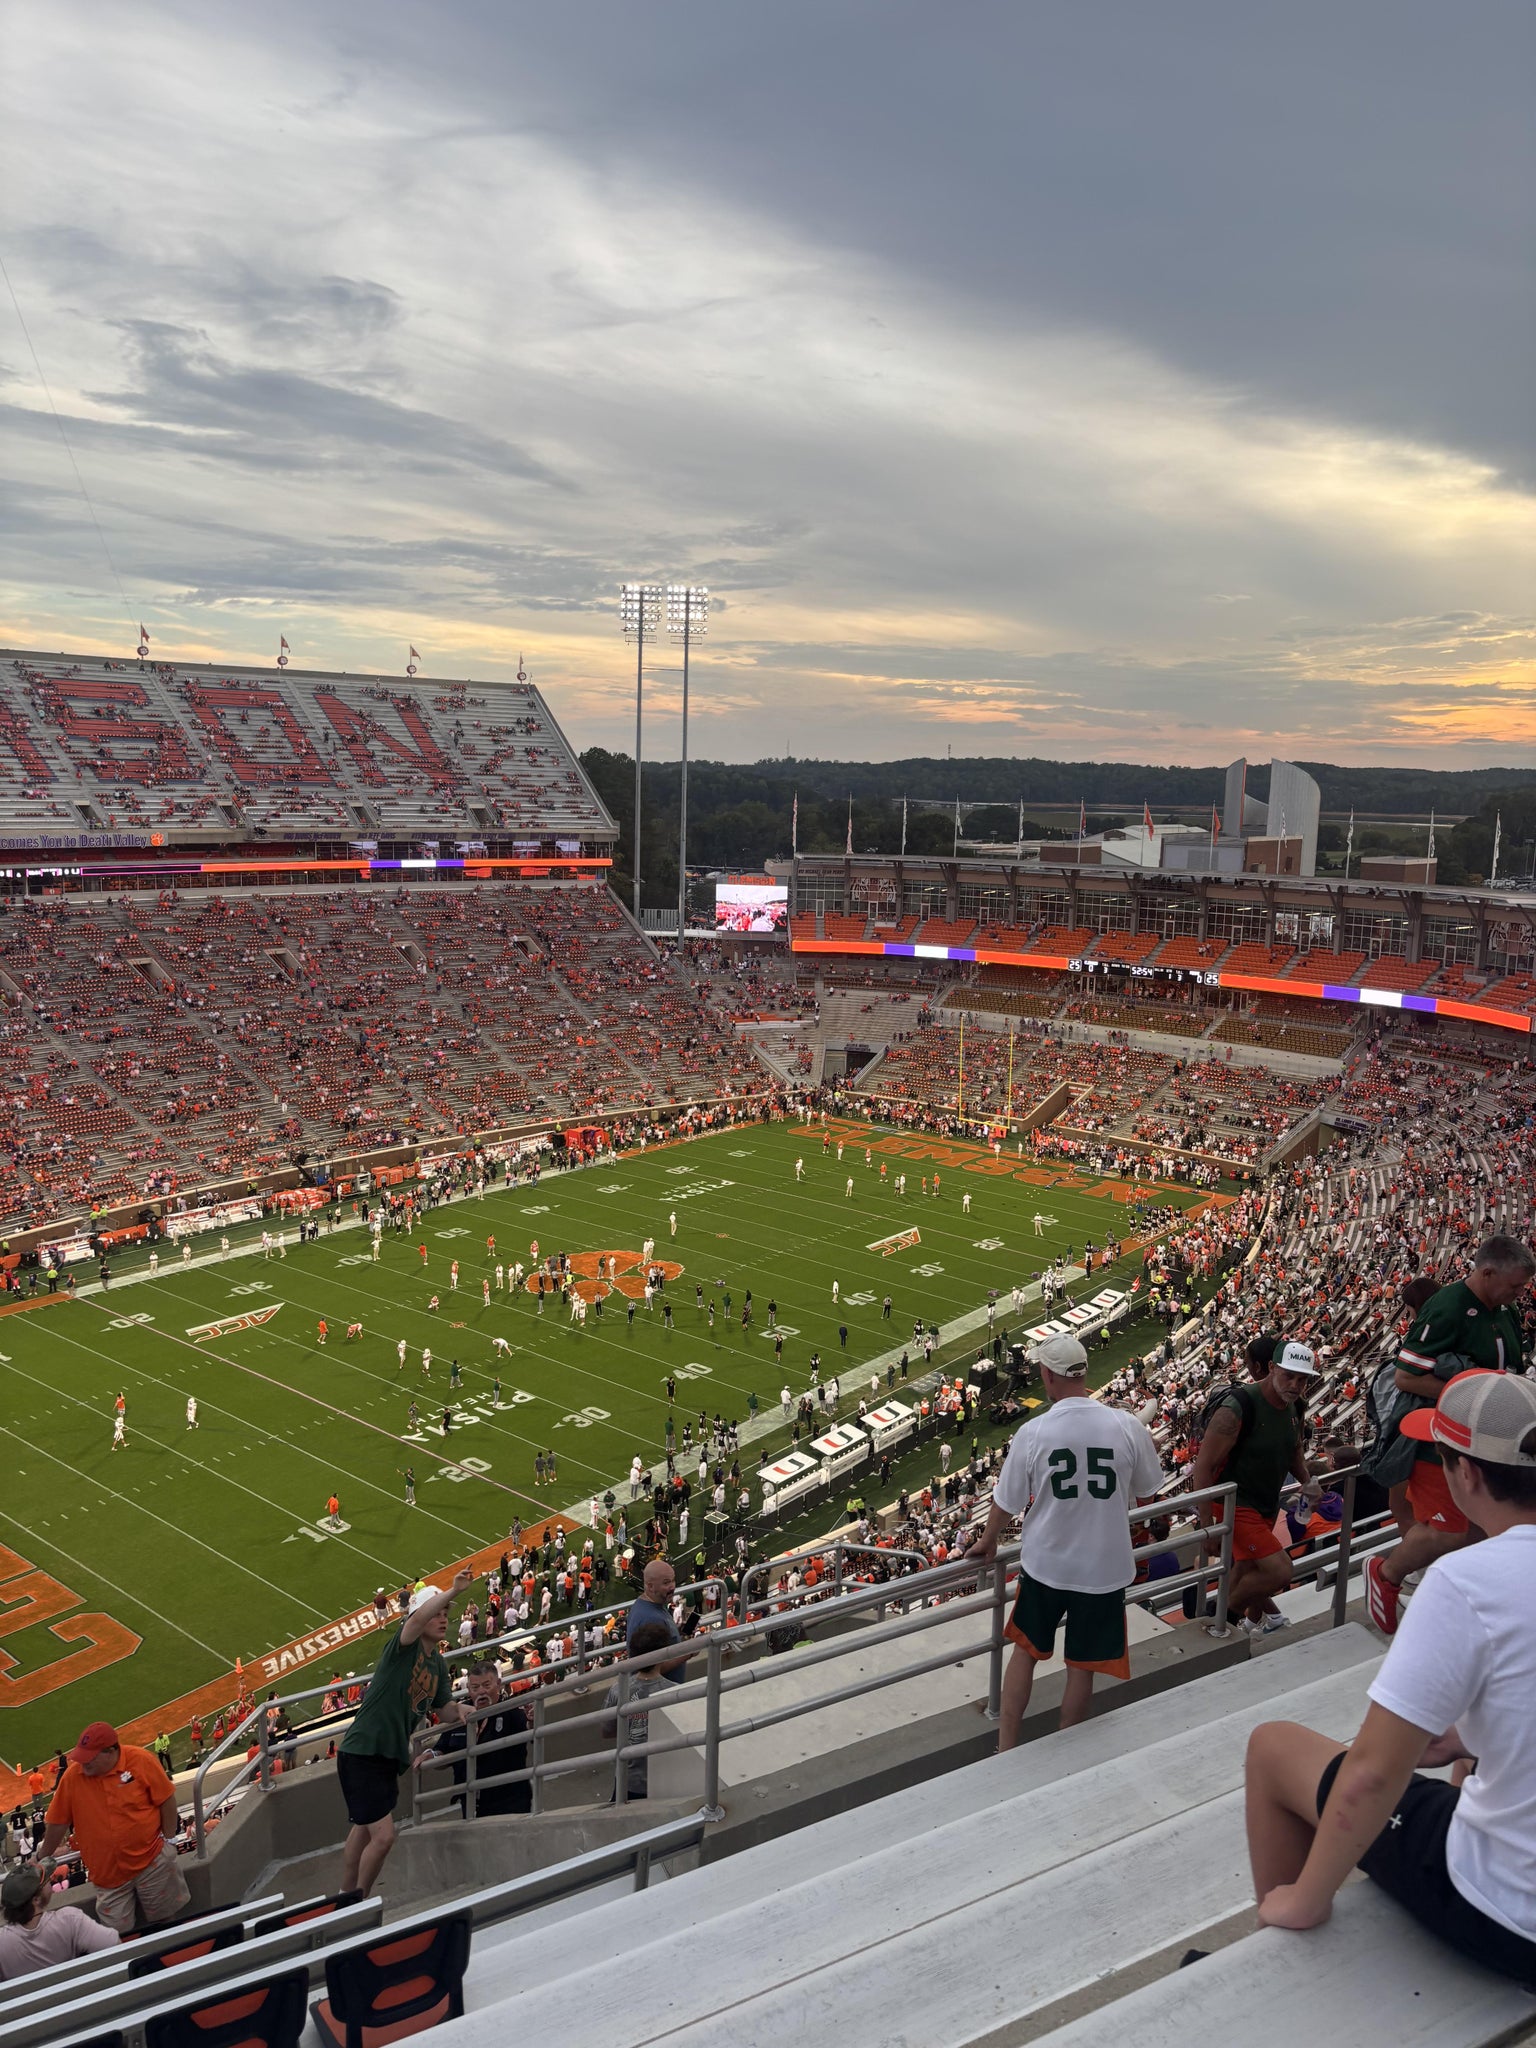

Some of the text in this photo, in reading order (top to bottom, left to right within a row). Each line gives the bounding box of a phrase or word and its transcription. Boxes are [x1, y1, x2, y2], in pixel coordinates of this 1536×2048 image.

[40, 835, 63, 848] You
[64, 835, 77, 847] to
[80, 834, 112, 847] Death
[114, 834, 147, 849] Valley
[727, 875, 776, 885] CLEMSON
[1069, 960, 1080, 970] 25
[1206, 973, 1218, 984] 25
[865, 1226, 921, 1257] ACC
[185, 1302, 285, 1344] ACC
[1289, 1352, 1311, 1364] MIAMI
[672, 1362, 713, 1380] 40
[562, 1406, 612, 1428] 30
[438, 1457, 493, 1483] 20
[1048, 1447, 1117, 1500] 25
[297, 1516, 352, 1543] 10
